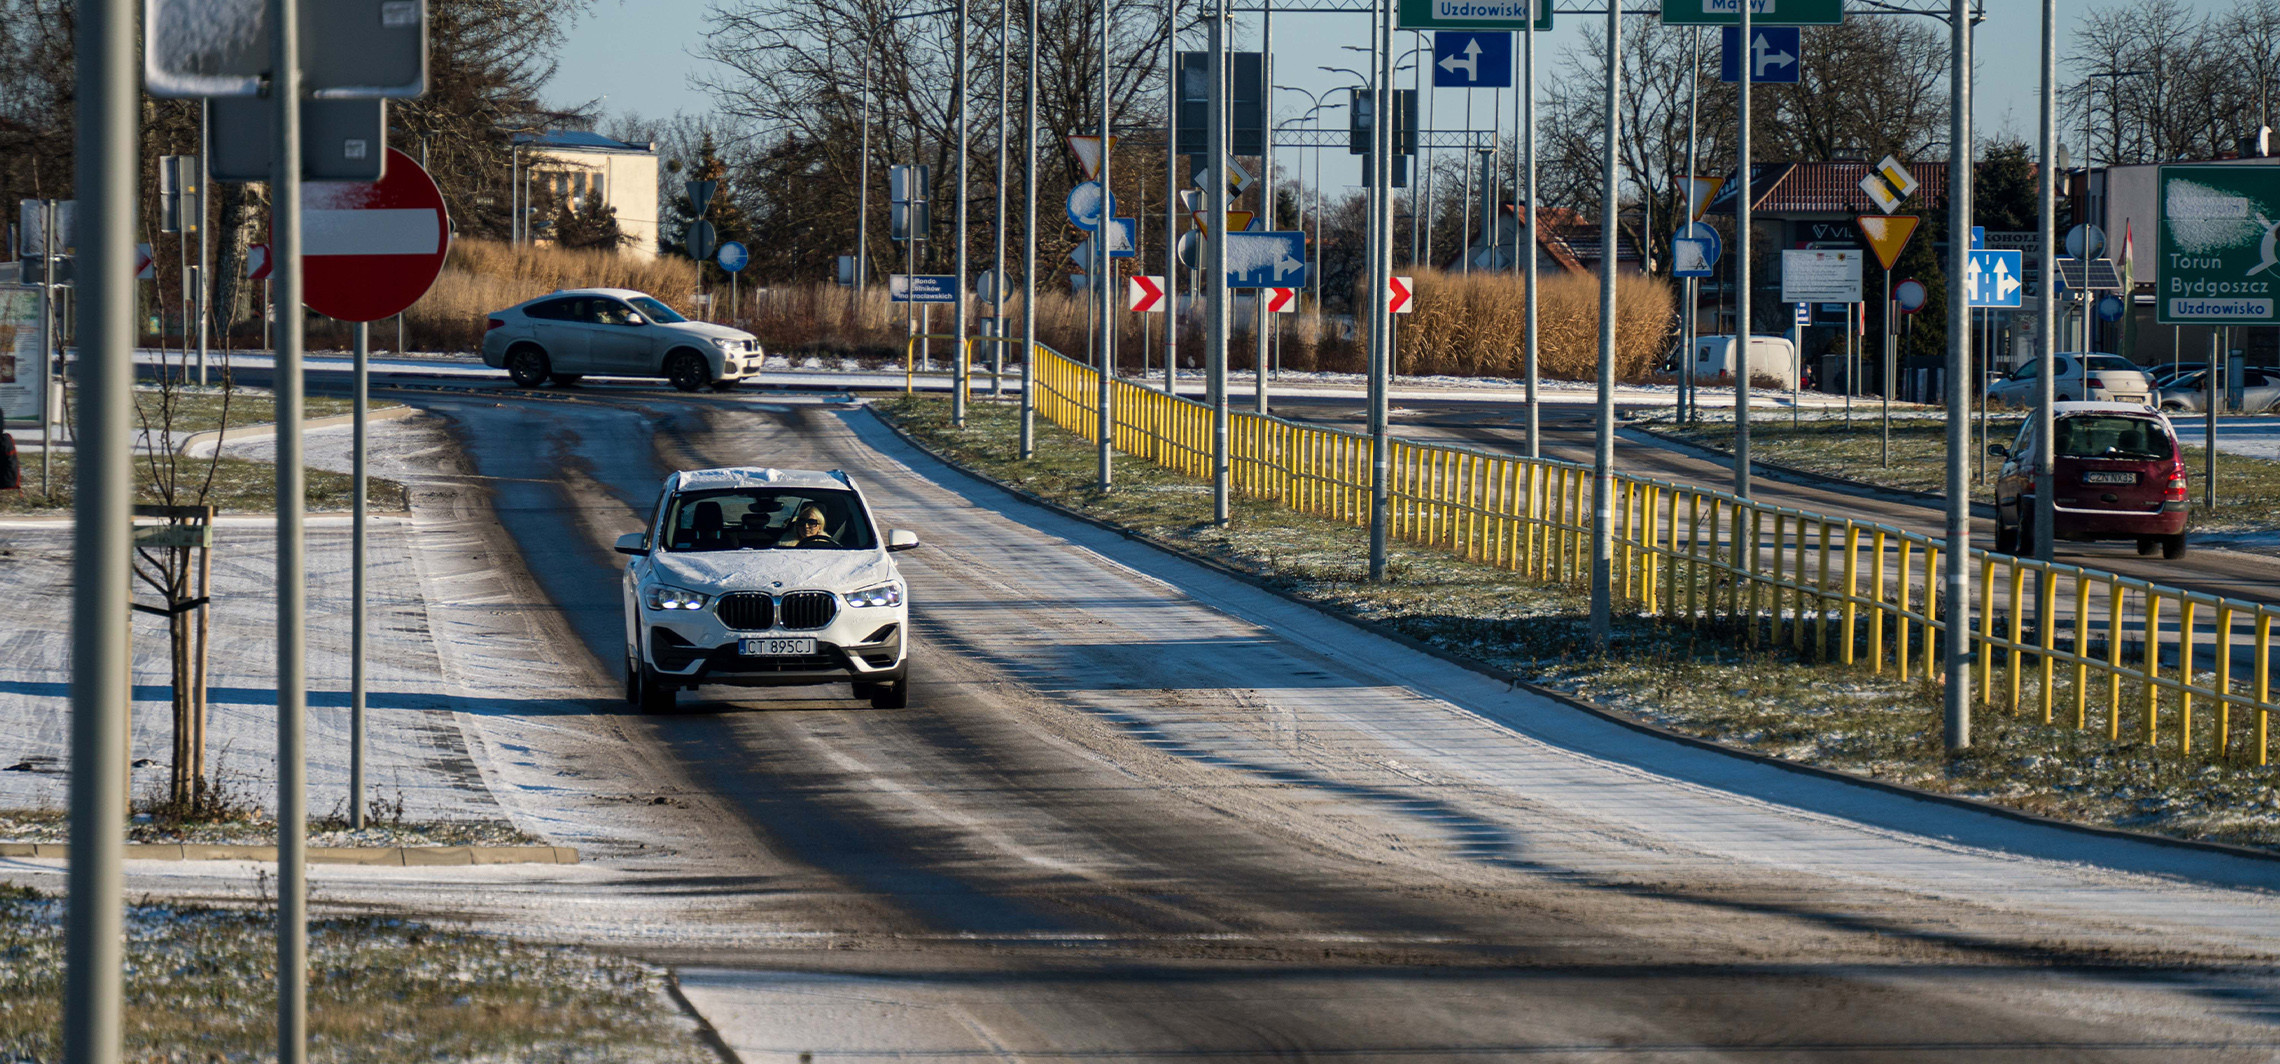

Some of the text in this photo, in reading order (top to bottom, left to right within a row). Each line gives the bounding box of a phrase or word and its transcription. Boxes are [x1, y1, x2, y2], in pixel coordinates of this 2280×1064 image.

[1712, 0, 1765, 13] Mąwy
[2171, 277, 2269, 297] Bydgoszcz
[2177, 301, 2265, 315] Uzdrowisko
[748, 640, 811, 654] CT 895CJ
